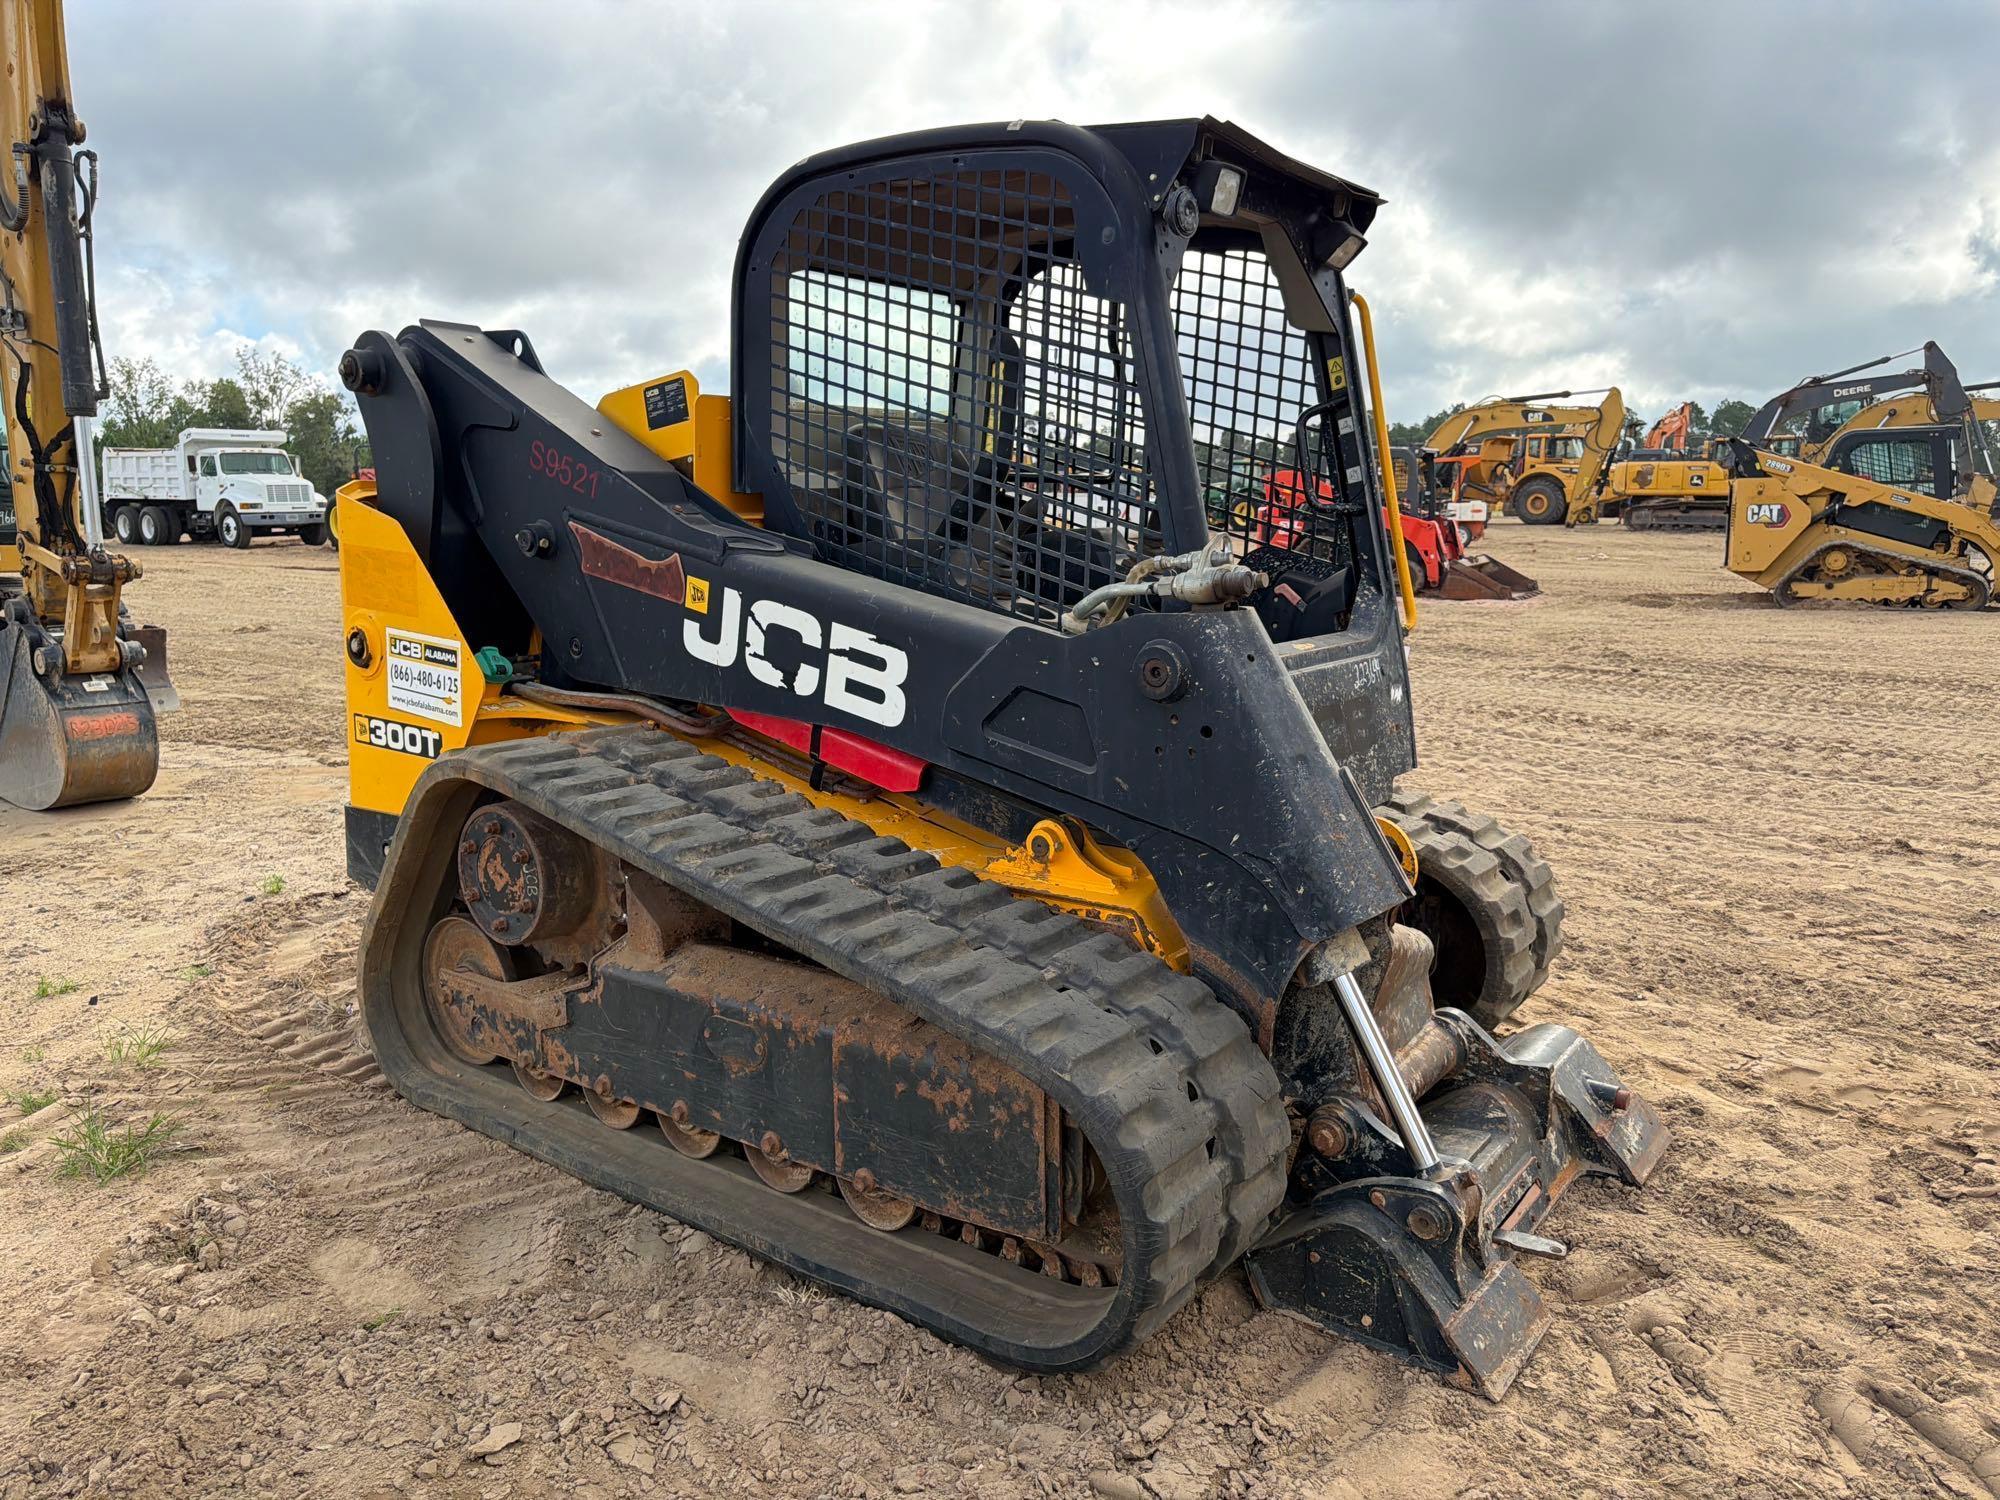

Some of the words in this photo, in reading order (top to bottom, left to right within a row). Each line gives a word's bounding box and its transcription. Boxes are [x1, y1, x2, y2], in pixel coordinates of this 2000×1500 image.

[1833, 384, 1872, 398] DEERE
[1527, 412, 1544, 423] CAT
[529, 440, 599, 499] S9521
[1747, 503, 1781, 524] CAT
[691, 586, 706, 601] JCB
[391, 638, 422, 659] JCB
[425, 648, 457, 664] ALABAMA
[683, 586, 909, 728] JCB
[390, 663, 458, 694] (866)-480-6125
[391, 695, 459, 718] www.jcbofalabama.com
[369, 718, 440, 758] 300T
[522, 863, 539, 897] JCB
